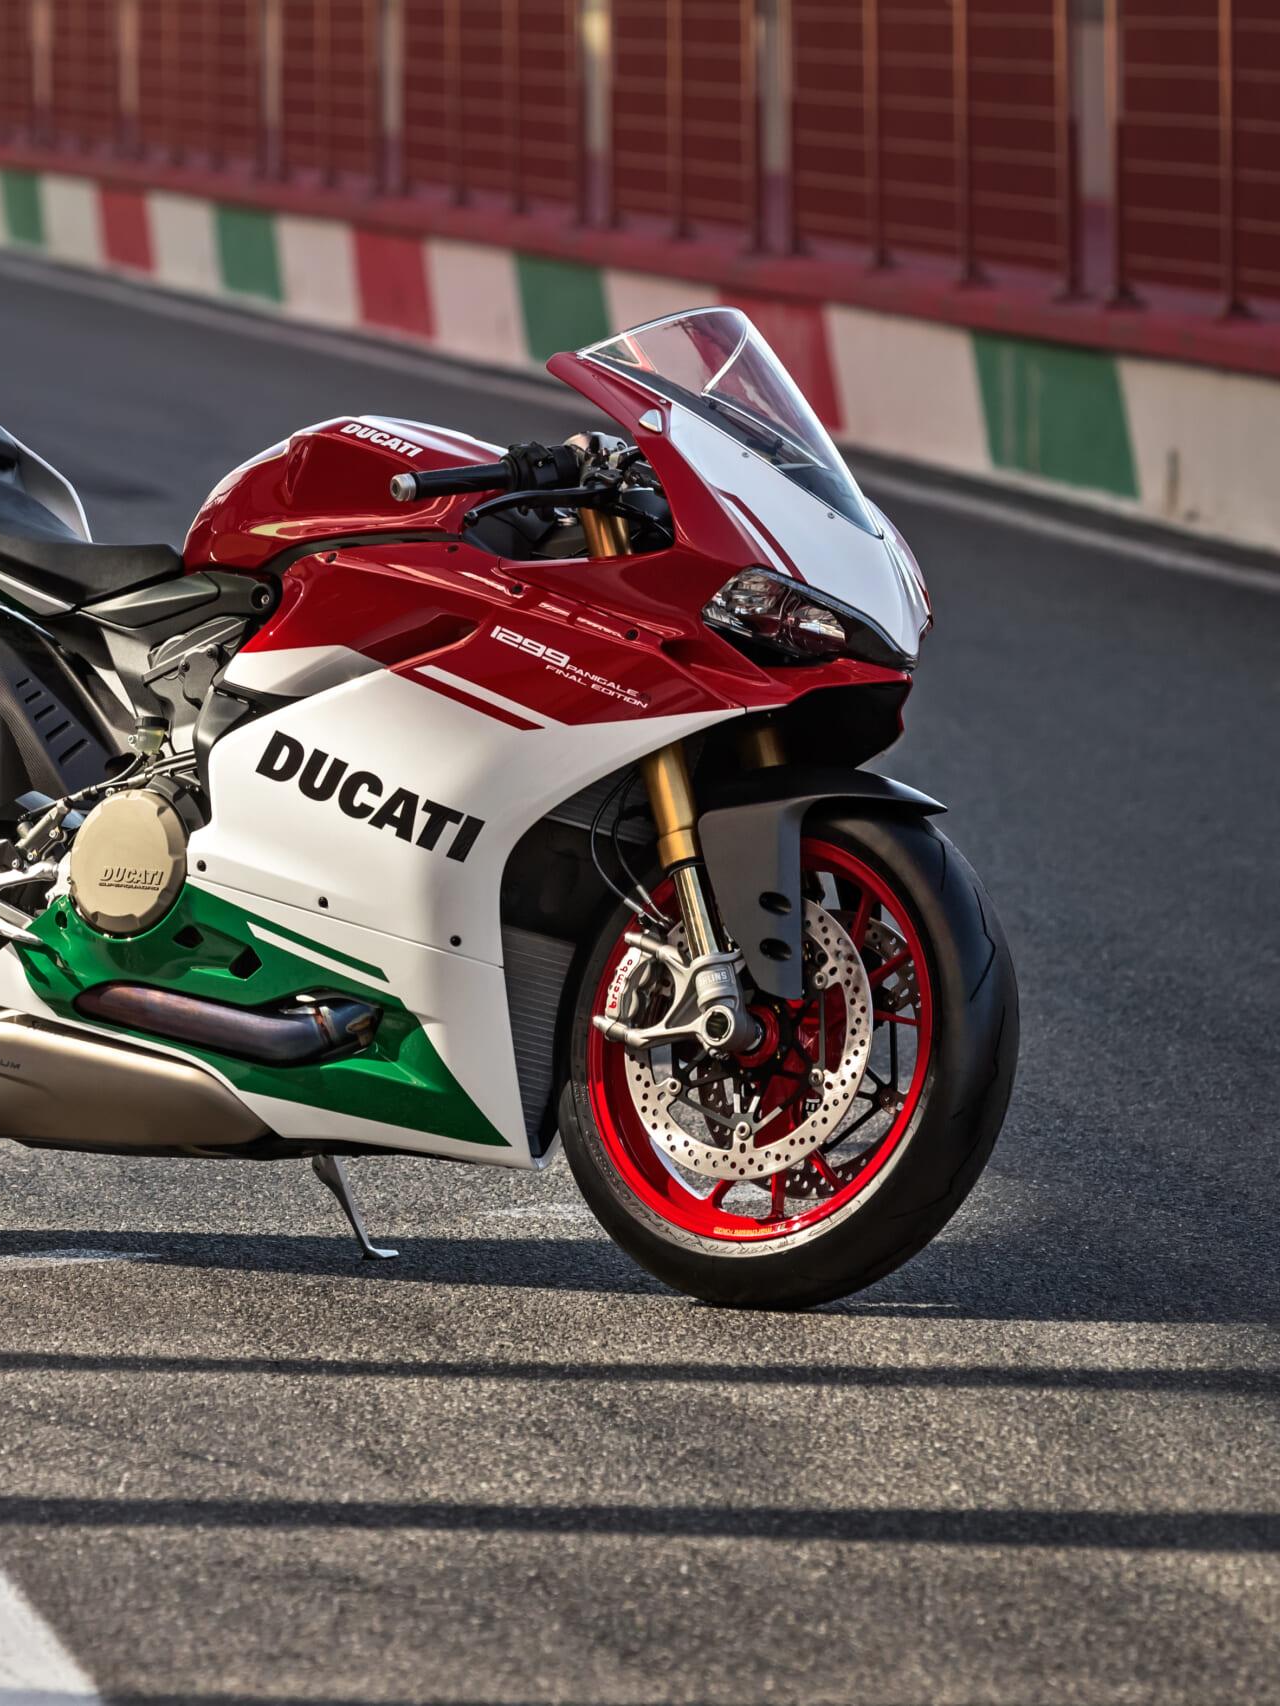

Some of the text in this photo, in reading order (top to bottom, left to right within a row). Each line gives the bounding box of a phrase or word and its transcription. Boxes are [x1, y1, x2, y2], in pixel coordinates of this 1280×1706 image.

[340, 423, 424, 458] DUCATI
[490, 625, 639, 697] 1299 PANIGALE
[545, 664, 648, 708] FINAL EDITION
[255, 730, 486, 863] DUCATI
[100, 866, 164, 885] DUCATI
[608, 959, 633, 1009] brembo
